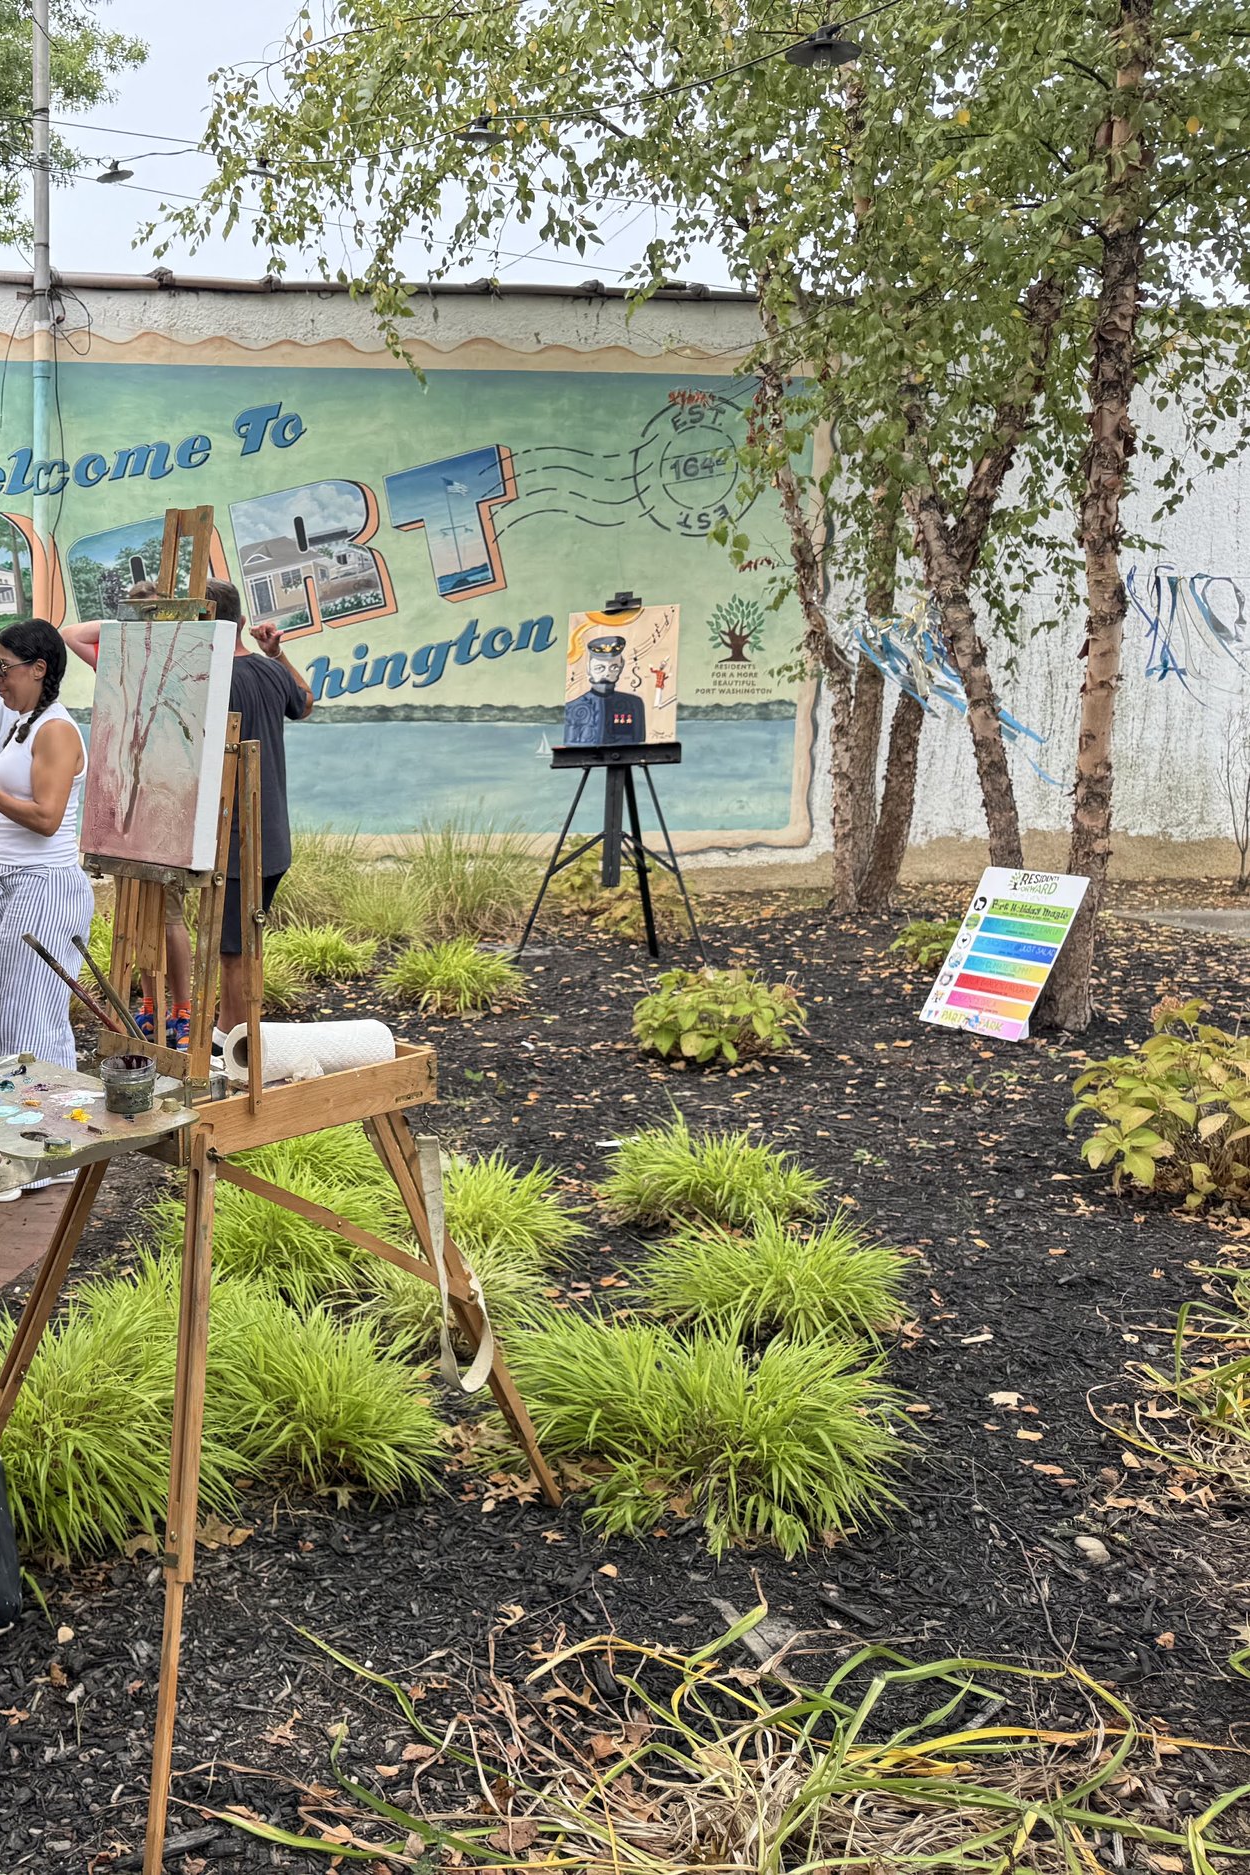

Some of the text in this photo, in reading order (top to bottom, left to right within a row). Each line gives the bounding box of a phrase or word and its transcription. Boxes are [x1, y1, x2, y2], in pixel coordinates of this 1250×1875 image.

[233, 401, 307, 457] To
[671, 404, 726, 432] EST.
[306, 614, 558, 702] hington
